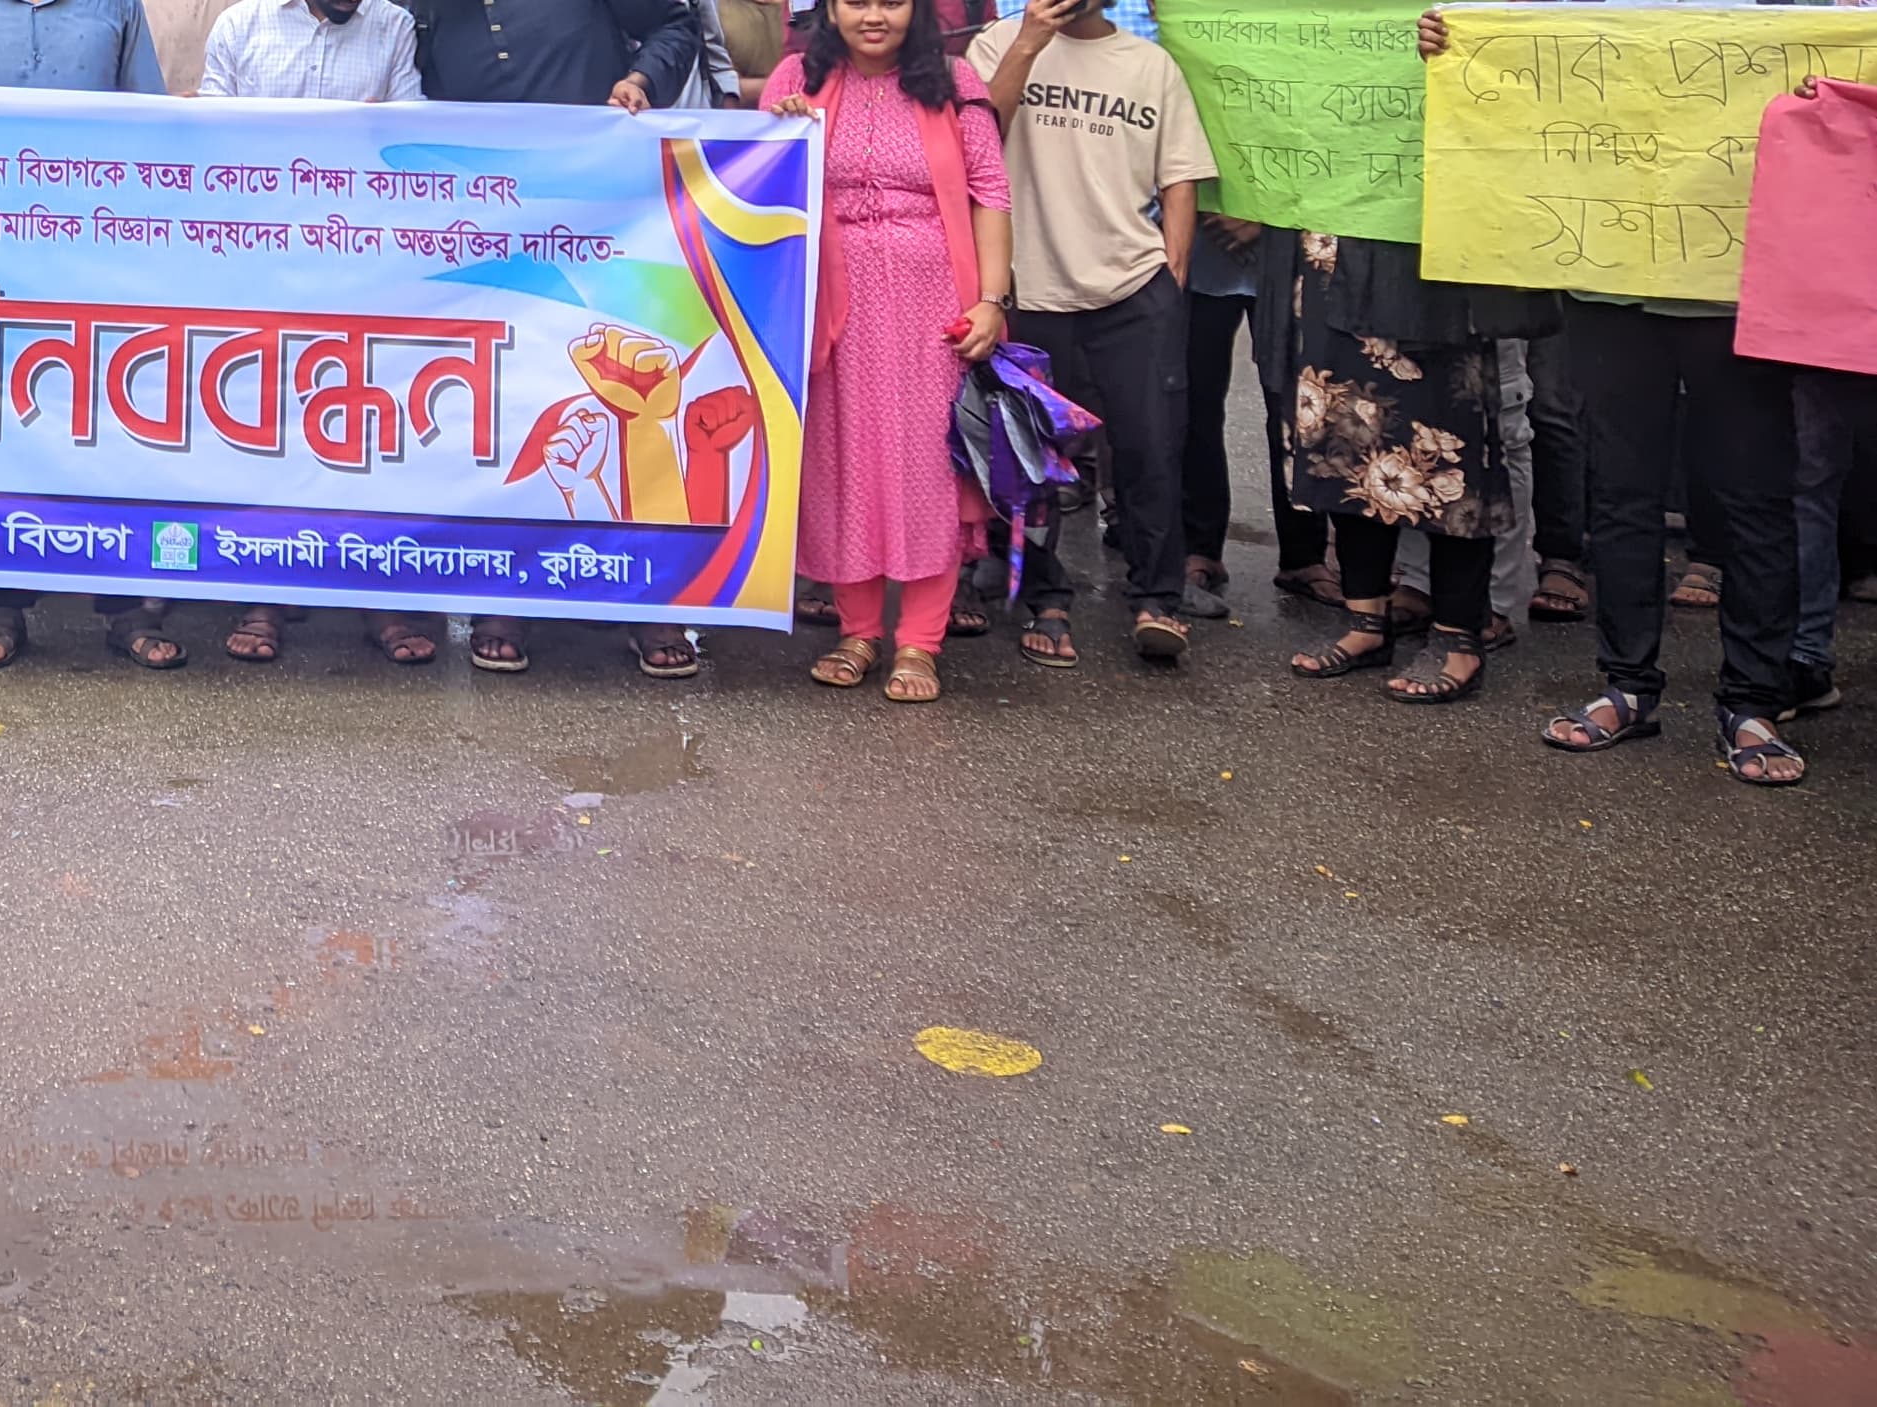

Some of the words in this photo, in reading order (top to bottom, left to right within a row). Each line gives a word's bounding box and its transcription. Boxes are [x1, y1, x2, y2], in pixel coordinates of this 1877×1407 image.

[1211, 64, 1305, 117] শিক্ষা
[1462, 33, 1622, 105] লোক
[1019, 82, 1158, 131] SENTIALS
[1035, 112, 1068, 129] FEAR
[1089, 122, 1115, 138] GOD
[1534, 120, 1665, 166] নিশ্চিত
[19, 148, 126, 189] বিভাগকে
[134, 158, 196, 194] স্বতন্ত্র
[203, 162, 281, 195] কোডে
[290, 157, 355, 200] শিক্ষা
[366, 168, 458, 204] ক্যাডার
[465, 173, 521, 209] এবং
[93, 205, 171, 247] বিজ্ঞান
[180, 218, 290, 257] অনুষদের
[300, 212, 385, 254] অধীনে
[391, 219, 510, 267] অন্তর্ভুক্তির
[1, 511, 134, 562] বিভাগ
[214, 525, 331, 570] ইসলামী
